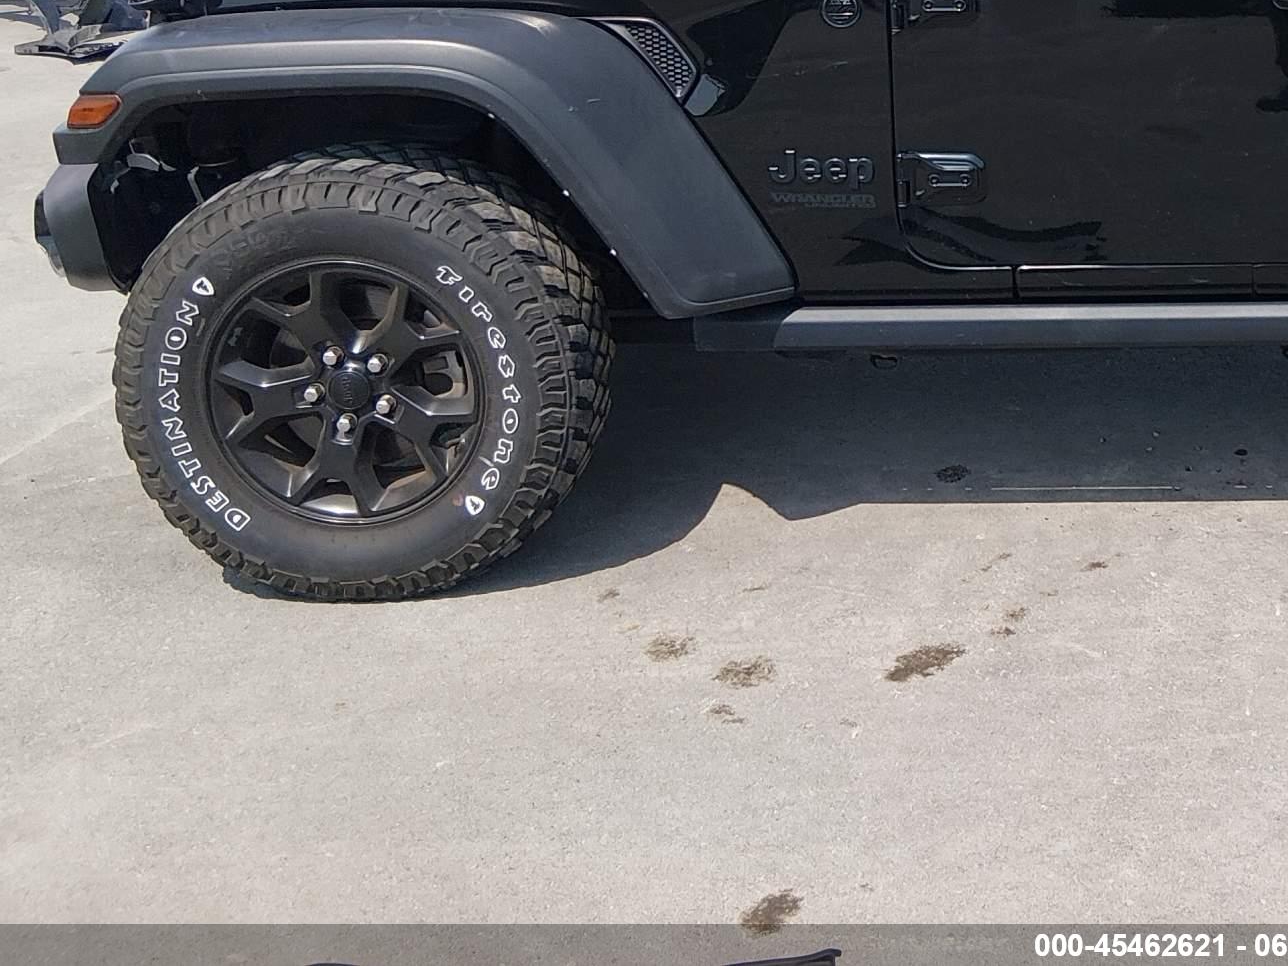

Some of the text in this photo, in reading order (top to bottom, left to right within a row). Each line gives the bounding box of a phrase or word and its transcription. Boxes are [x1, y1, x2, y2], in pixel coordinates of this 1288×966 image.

[768, 149, 875, 190] Jeep
[158, 300, 251, 532] DESTINATION
[435, 265, 522, 491] Firestone
